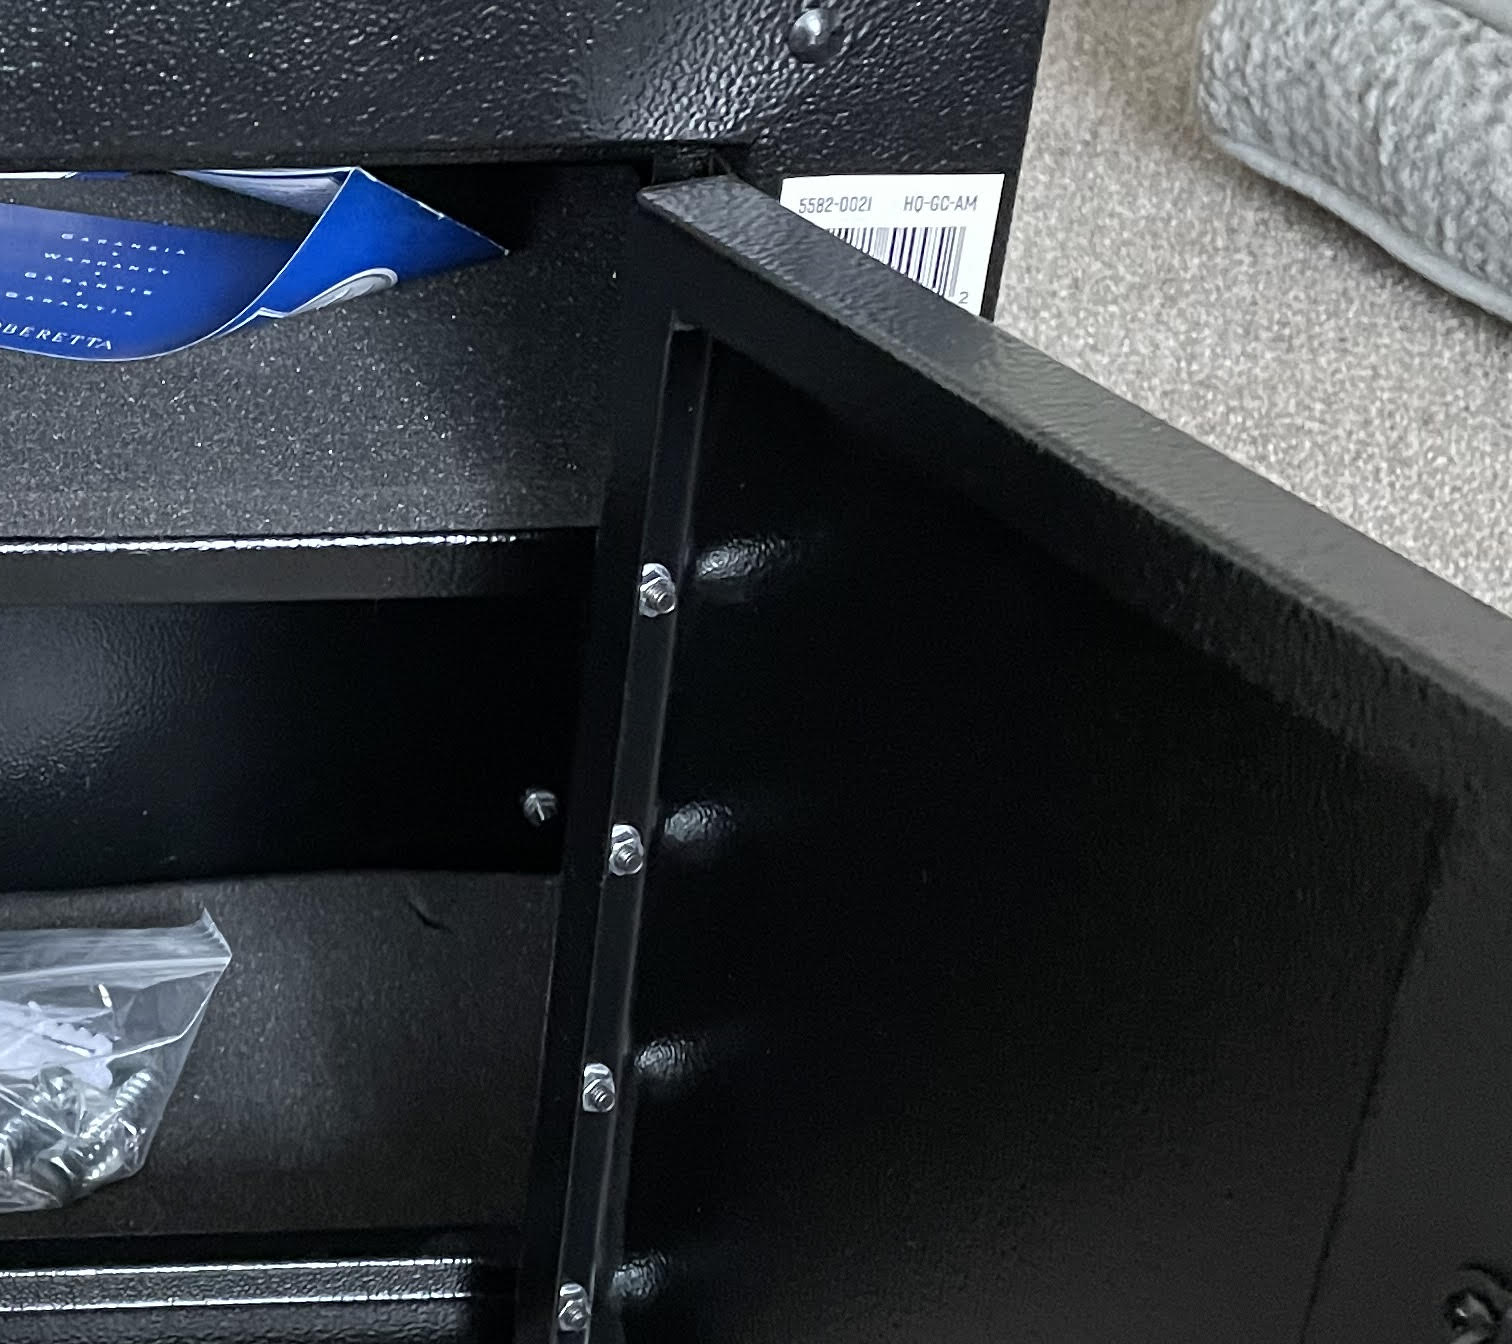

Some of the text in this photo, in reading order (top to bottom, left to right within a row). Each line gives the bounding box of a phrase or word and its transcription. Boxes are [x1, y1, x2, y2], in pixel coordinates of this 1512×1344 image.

[798, 196, 873, 214] 5582-0021
[43, 251, 170, 276] WARRANTY
[23, 271, 153, 296] GARANTIE
[958, 291, 969, 305] 2
[2, 322, 113, 351] BERETTA
